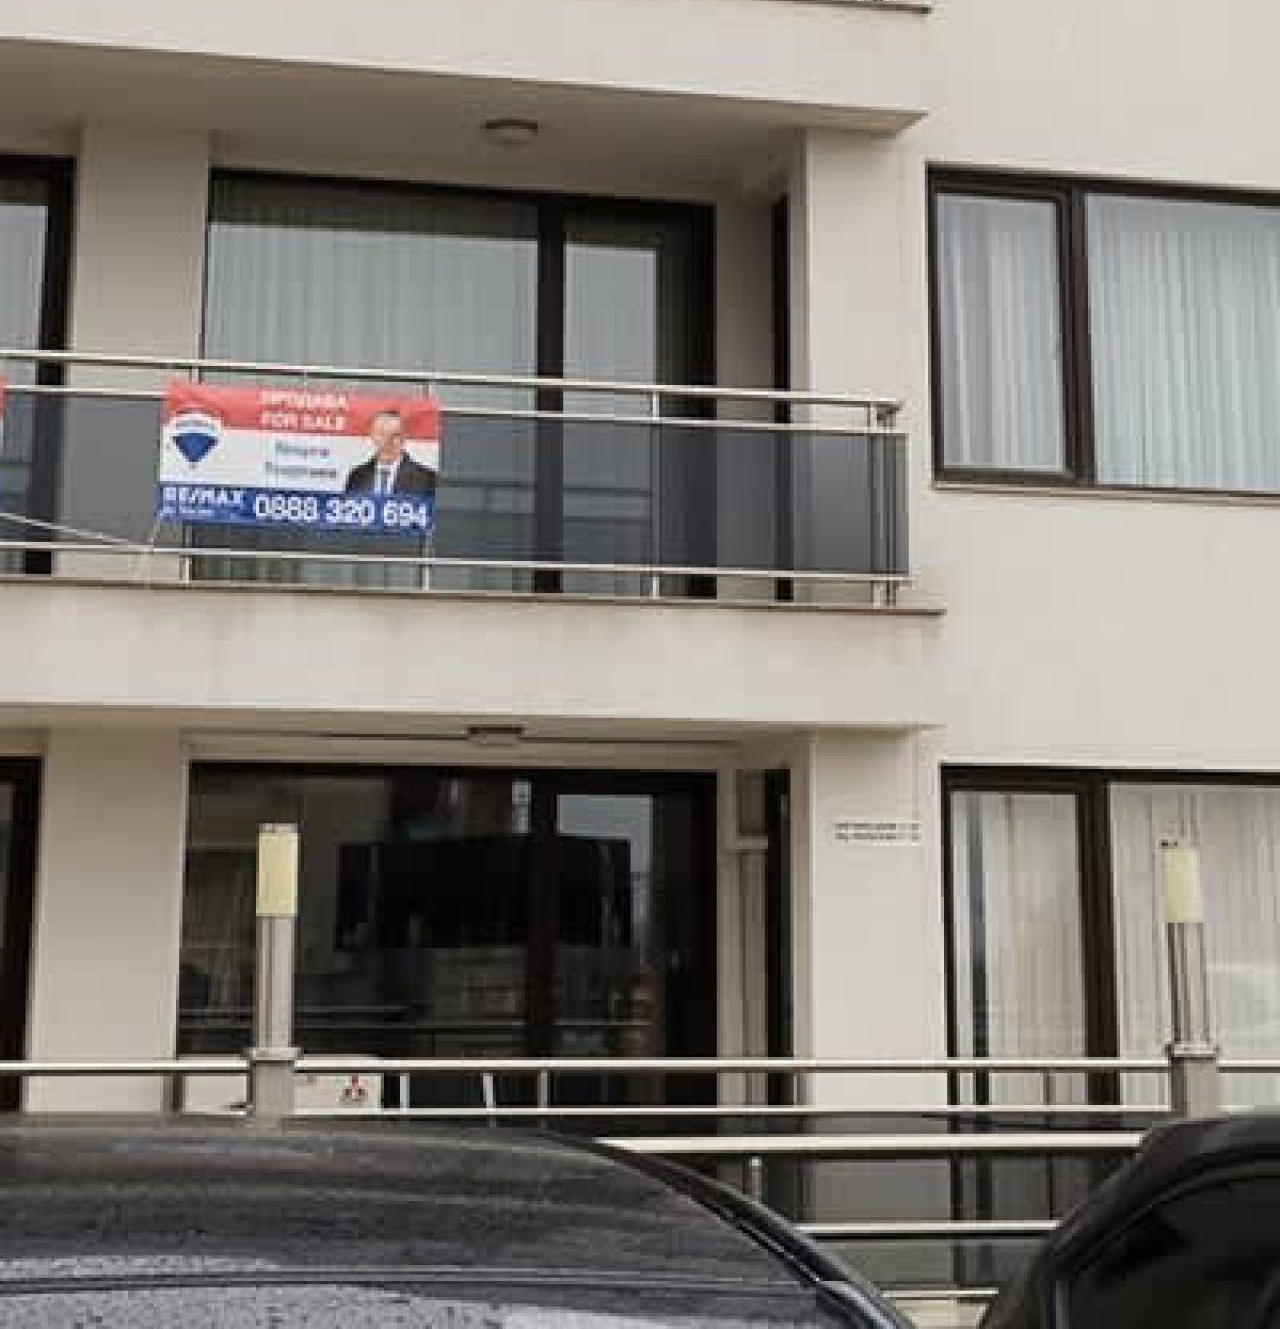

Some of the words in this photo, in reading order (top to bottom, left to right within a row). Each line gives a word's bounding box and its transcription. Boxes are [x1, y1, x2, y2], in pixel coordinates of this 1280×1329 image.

[259, 412, 298, 430] FOR
[303, 413, 347, 431] SALE
[163, 486, 244, 505] RE/MAX
[253, 495, 320, 521] 0888
[325, 498, 375, 524] 320
[382, 500, 429, 527] 694
